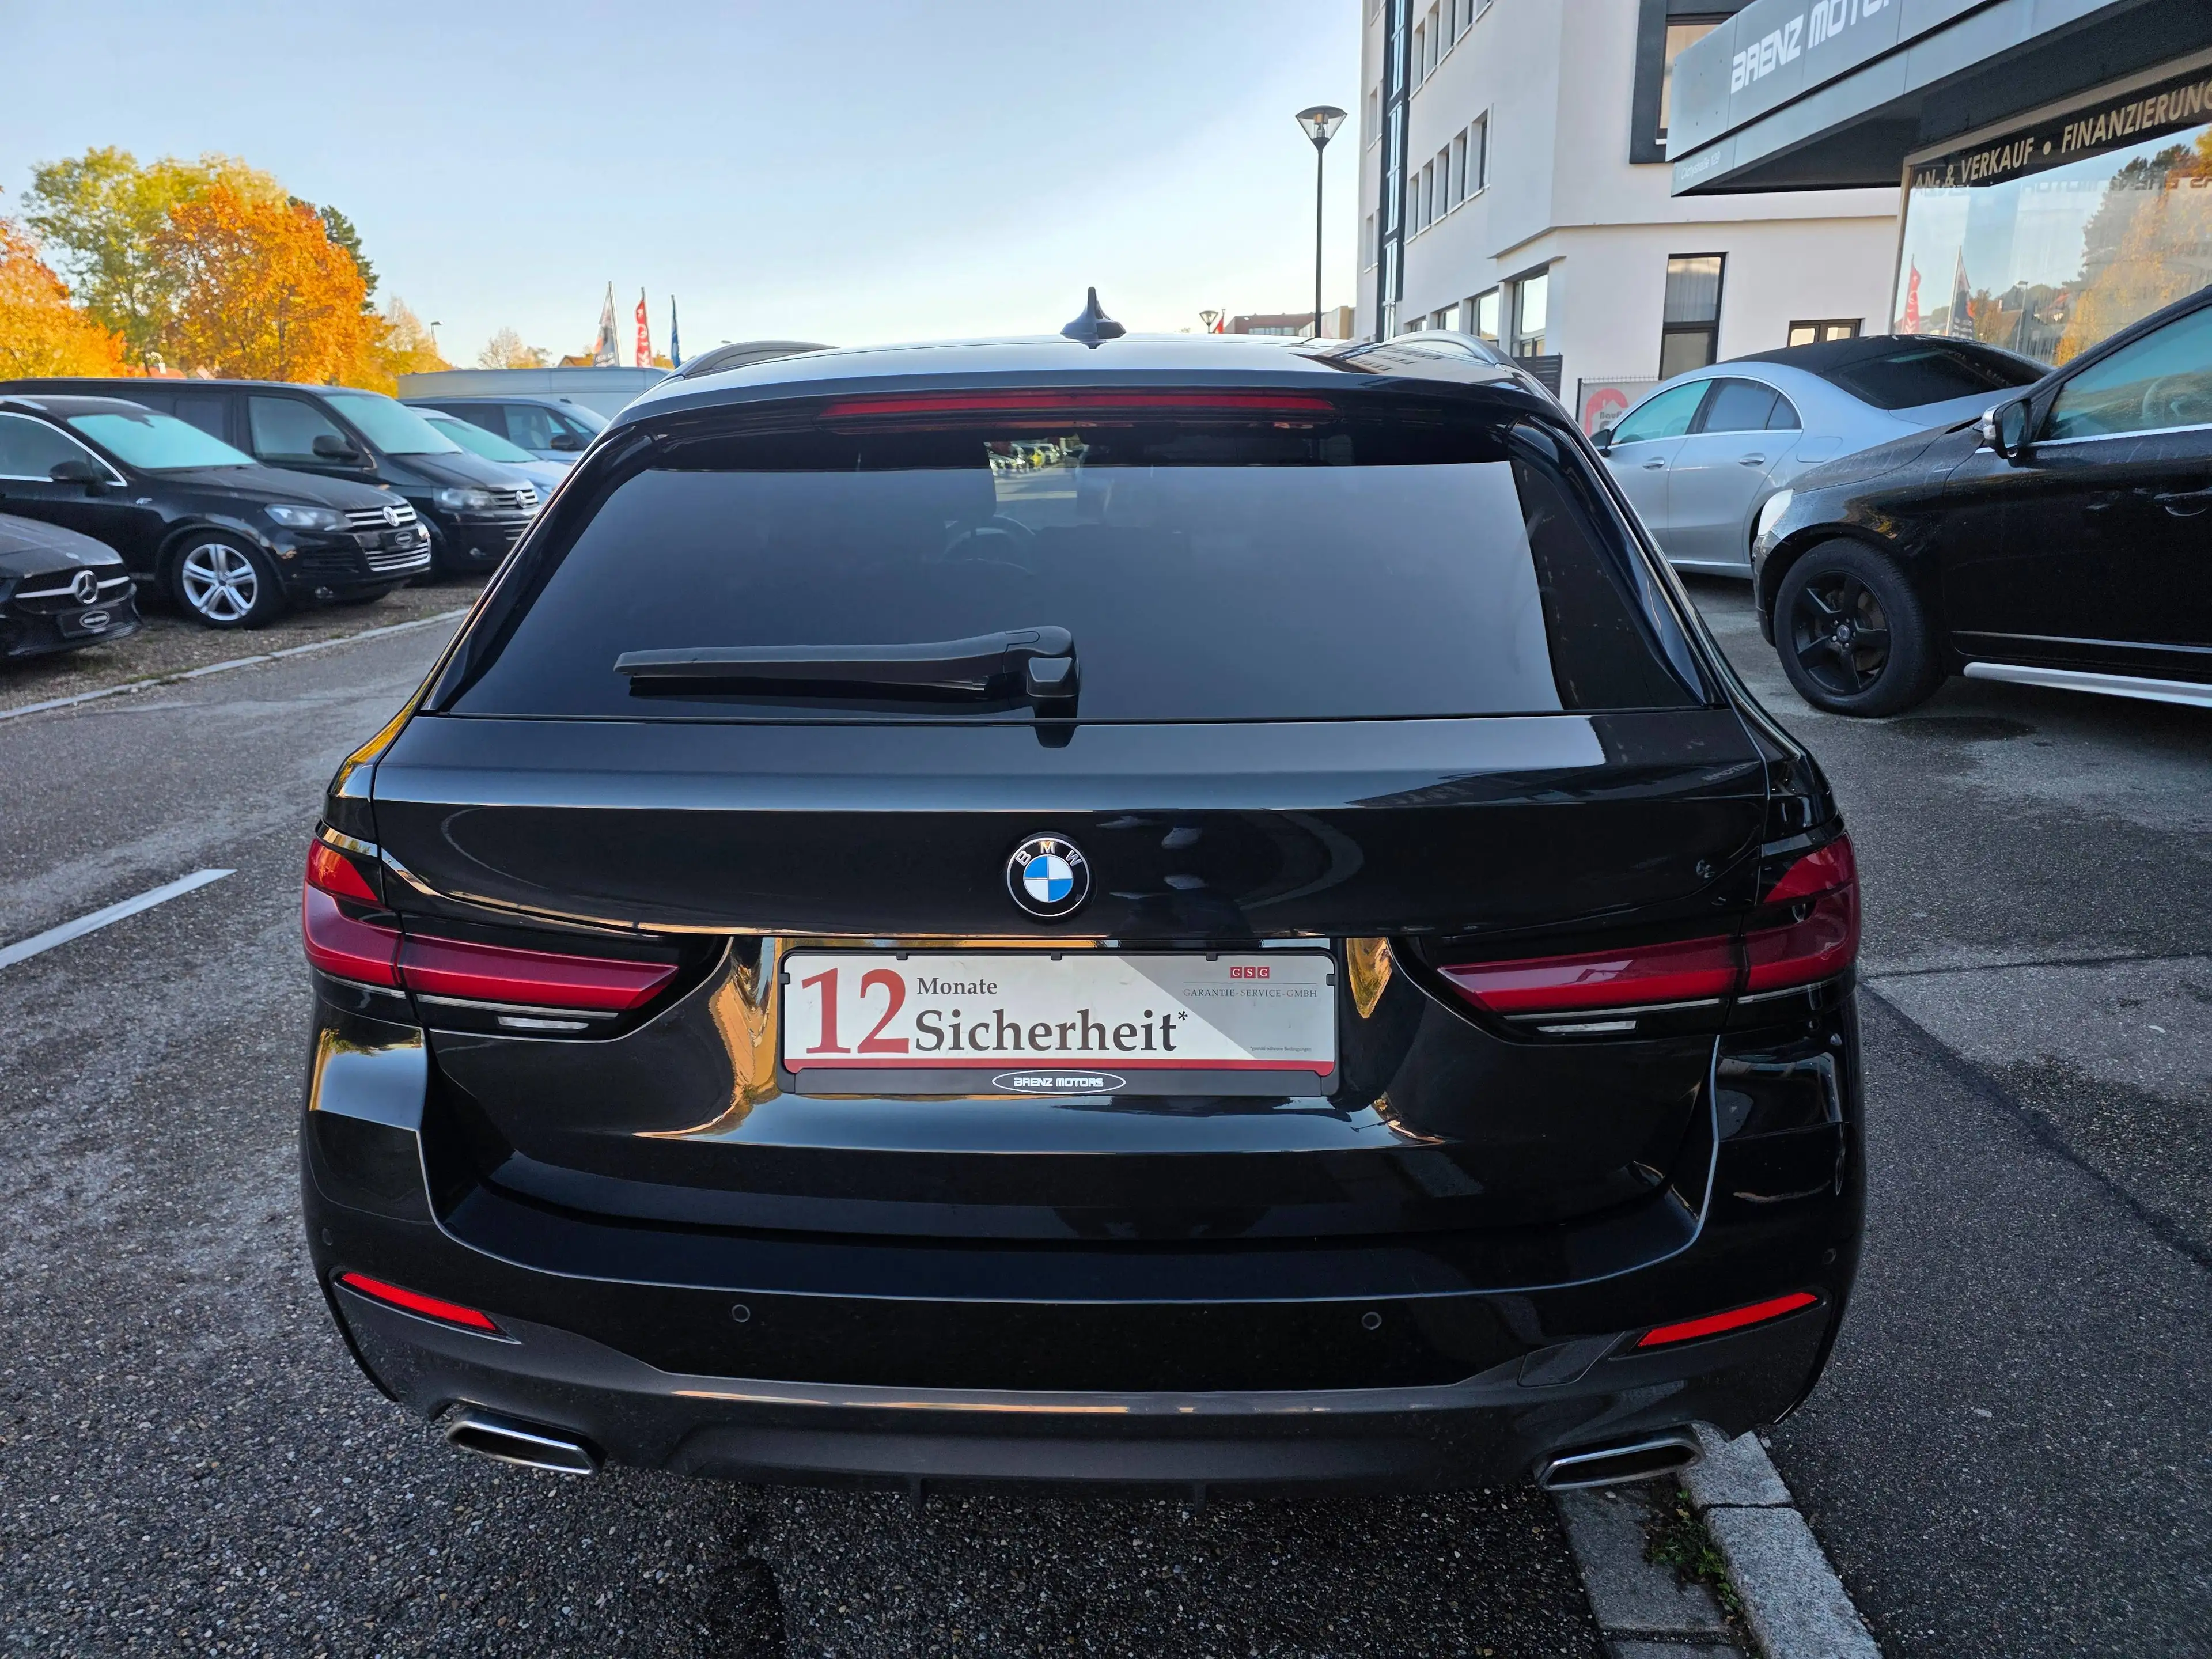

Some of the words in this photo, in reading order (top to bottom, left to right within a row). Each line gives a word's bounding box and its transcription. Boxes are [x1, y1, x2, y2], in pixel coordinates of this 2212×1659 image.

[1731, 14, 1804, 94] BRENZ
[1942, 165, 1956, 187] &
[1961, 137, 2035, 183] VERKAUF
[1016, 840, 1082, 866] BMW
[917, 978, 997, 994] Monate
[1231, 968, 1269, 978] GSG
[802, 967, 909, 1054] 12
[1014, 1077, 1053, 1086] BRENZ
[1056, 1078, 1104, 1087] MOTORS
